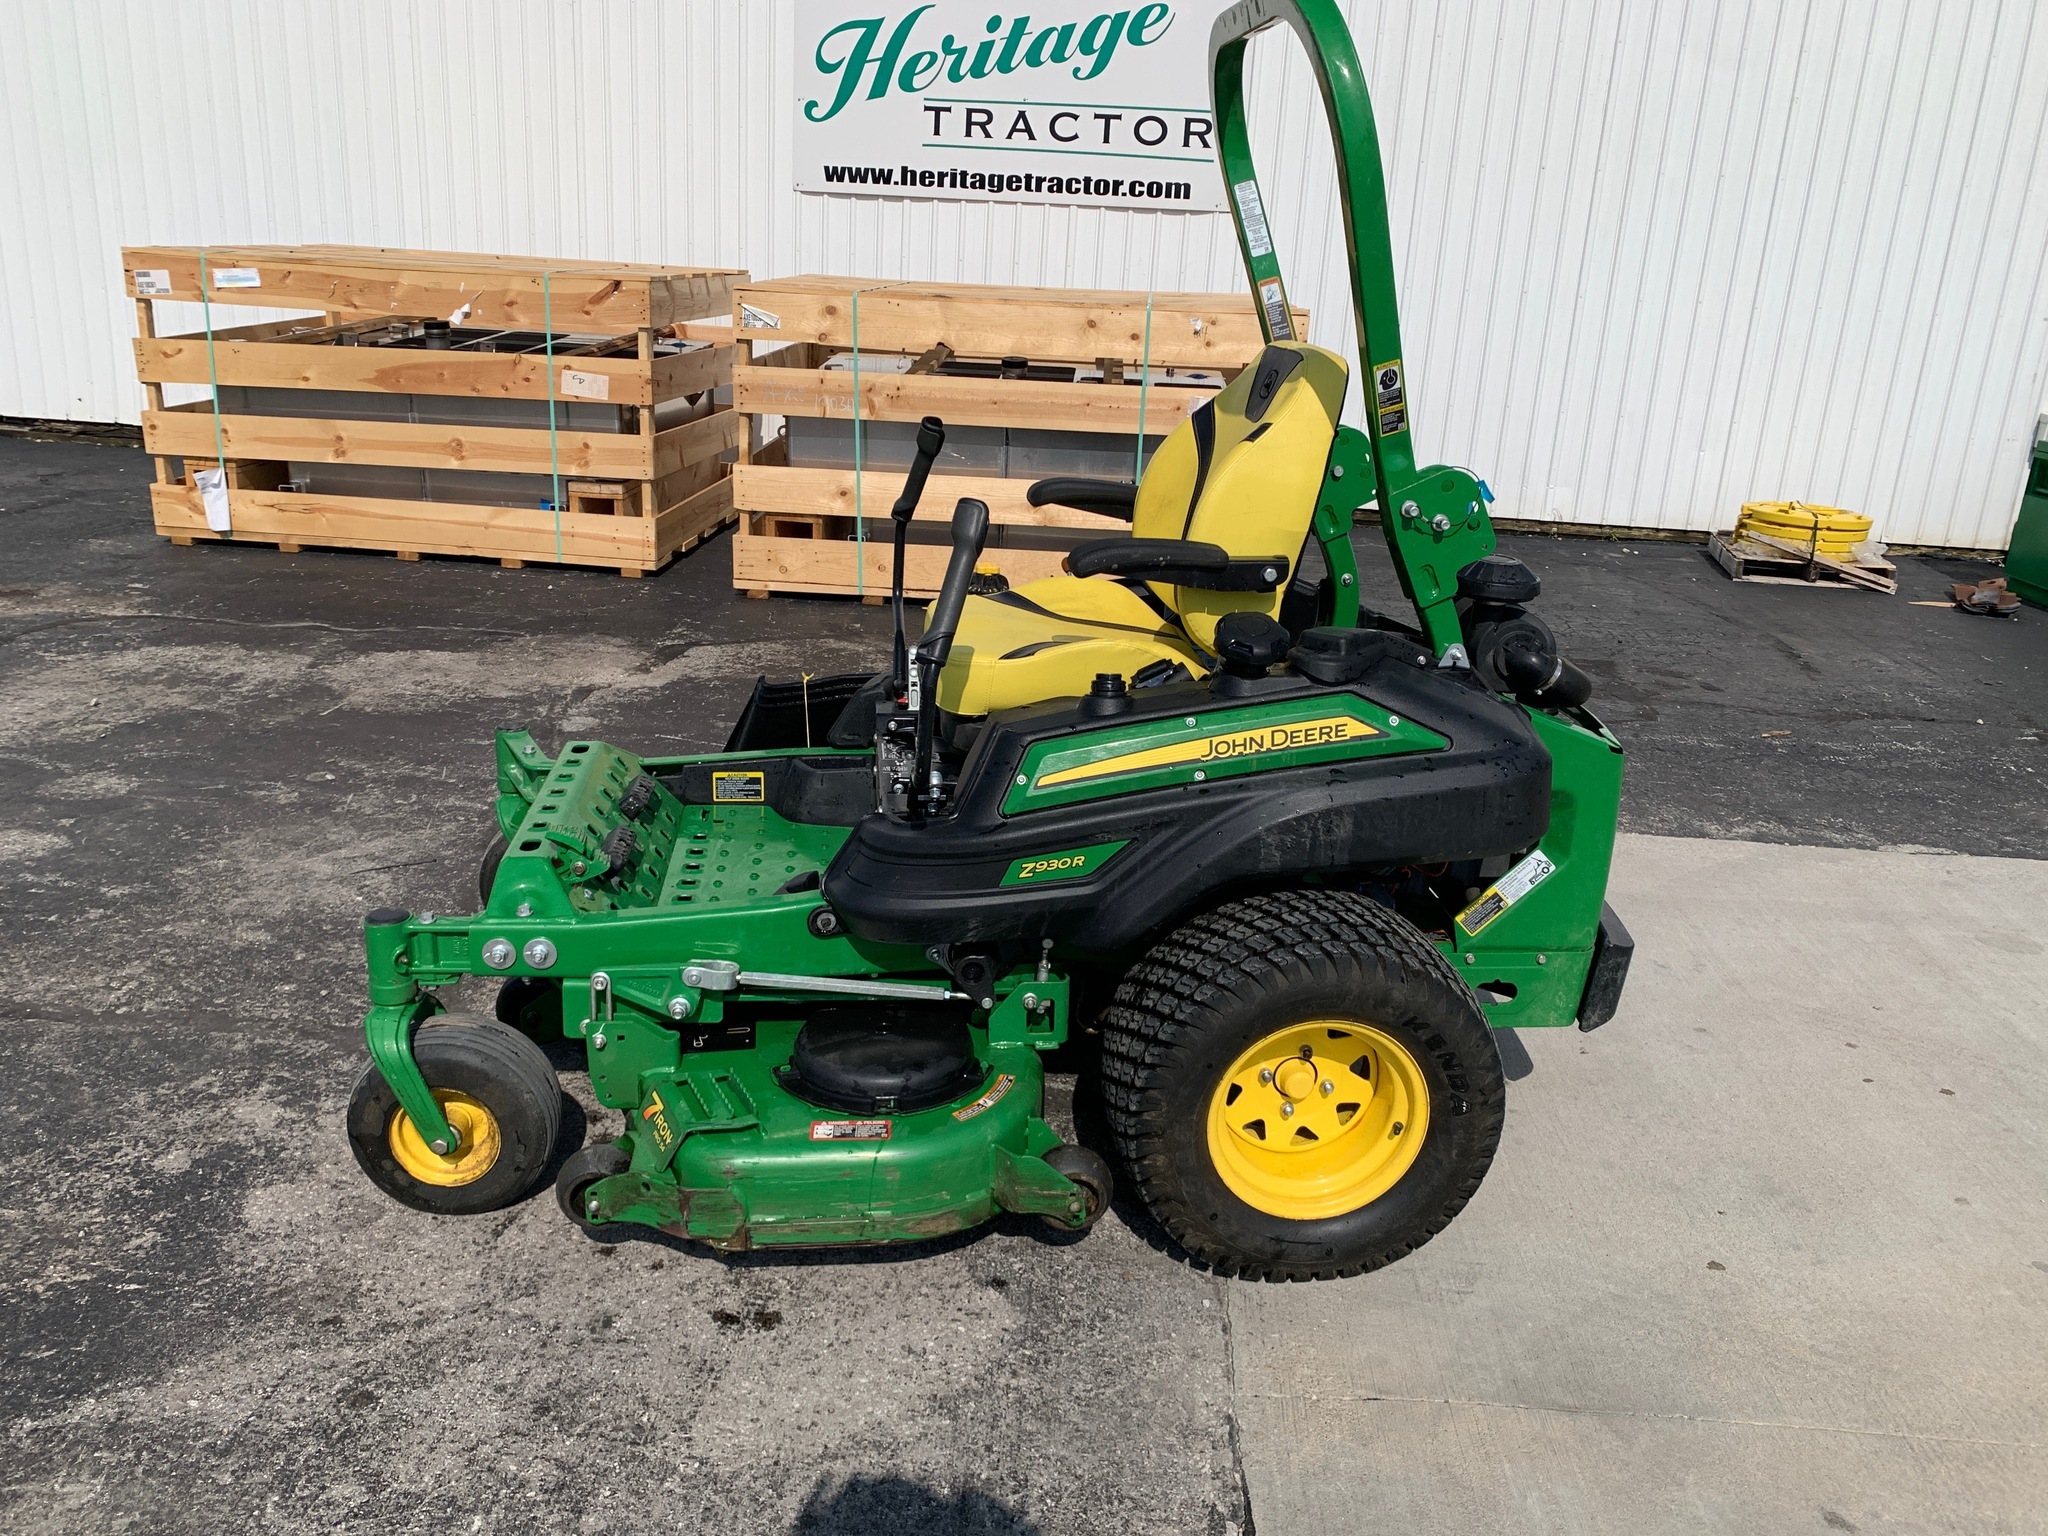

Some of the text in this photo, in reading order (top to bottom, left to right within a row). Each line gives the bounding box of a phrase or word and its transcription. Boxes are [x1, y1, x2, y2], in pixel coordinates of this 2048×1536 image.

[804, 3, 1176, 122] Heritage
[923, 104, 1212, 148] TRACTOR
[823, 165, 1191, 199] www.heritagetractor.com
[1200, 724, 1348, 758] JOHN DEERE
[1401, 1016, 1472, 1116] KENDA
